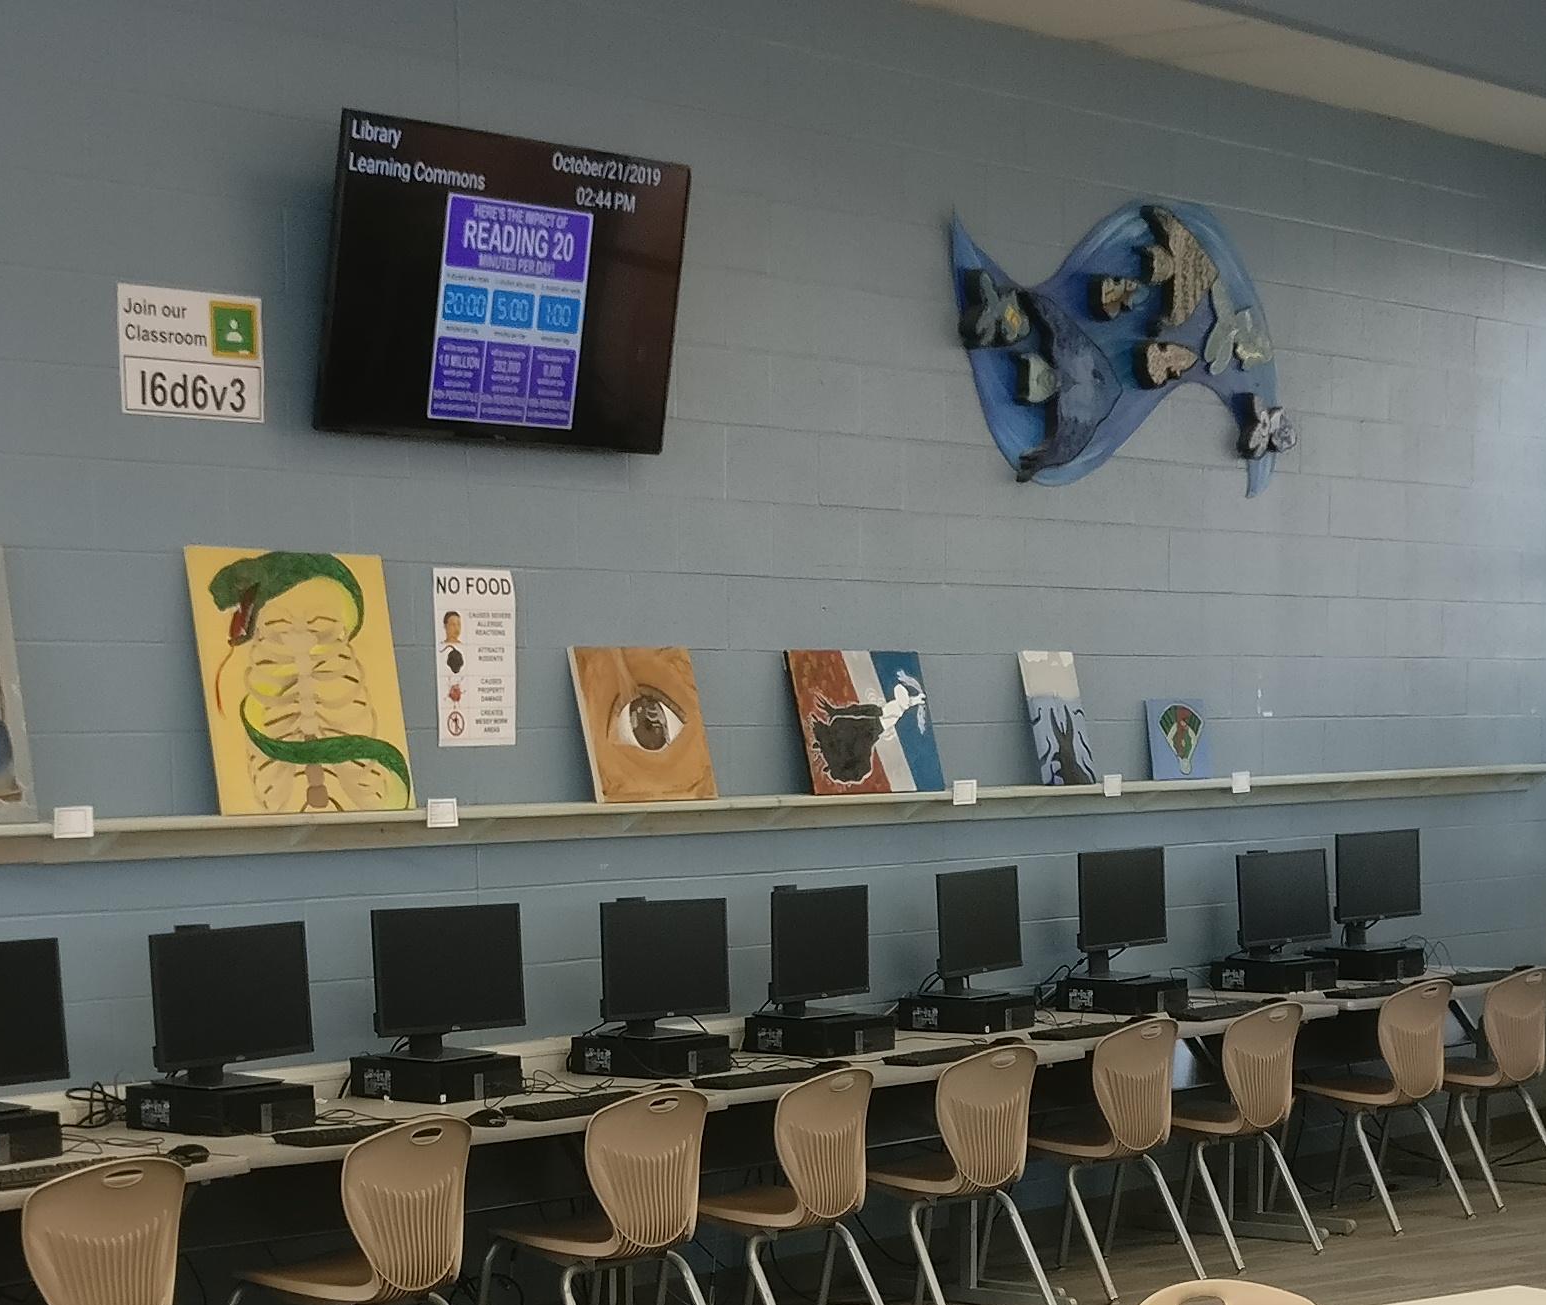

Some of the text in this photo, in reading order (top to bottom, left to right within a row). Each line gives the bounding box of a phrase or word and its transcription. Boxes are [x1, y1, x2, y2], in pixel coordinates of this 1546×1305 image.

[351, 118, 402, 148] Library
[349, 152, 486, 191] Learning Commons
[552, 151, 662, 188] October/21/2019
[575, 185, 636, 214] 02:44 PM
[507, 207, 523, 224] THE
[524, 210, 555, 228] IMPACT
[556, 215, 569, 229] OF
[463, 219, 574, 262] READING 20
[478, 253, 517, 272] MINUTES
[517, 258, 535, 274] PER
[123, 297, 188, 319] Join our
[125, 323, 207, 347] Classroom
[436, 575, 511, 595] NO FOOD
